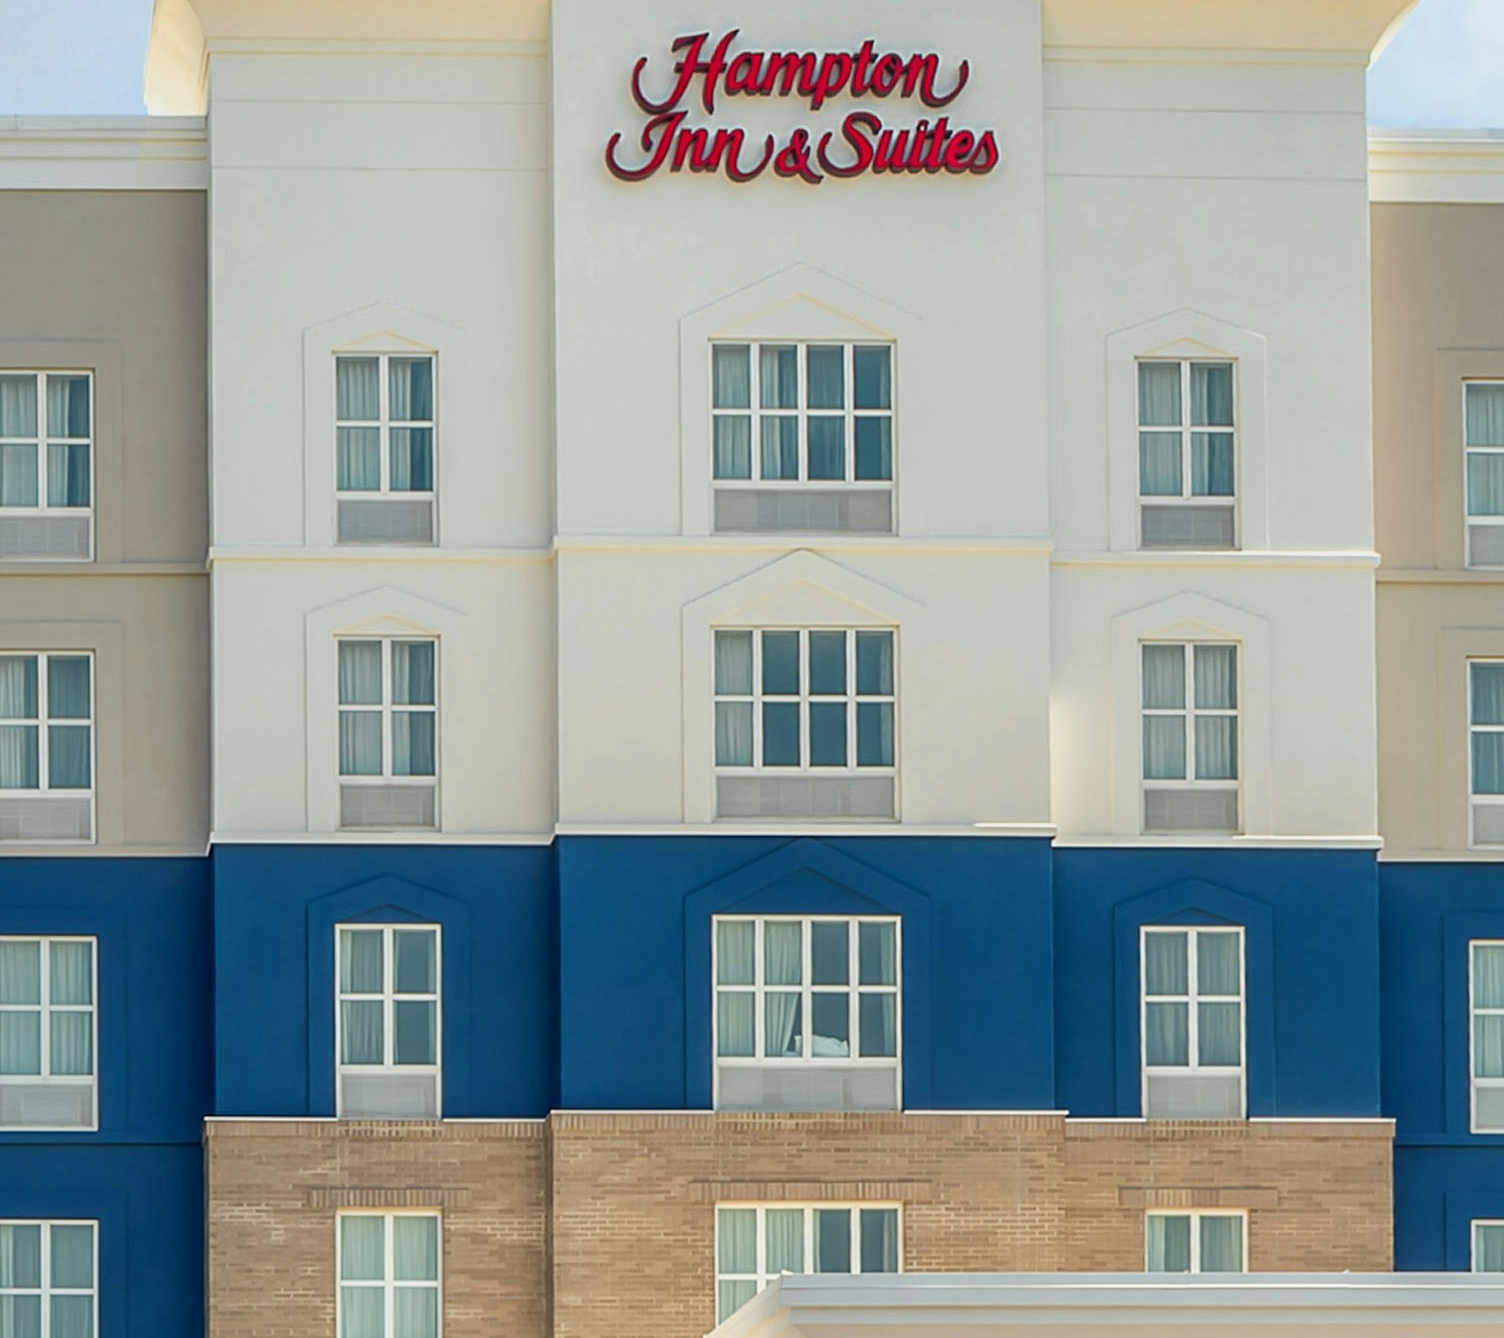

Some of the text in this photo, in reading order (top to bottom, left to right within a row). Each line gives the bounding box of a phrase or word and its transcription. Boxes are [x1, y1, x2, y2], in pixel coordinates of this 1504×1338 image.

[632, 28, 969, 115] Hampton
[605, 110, 999, 184] Inn & Suites
